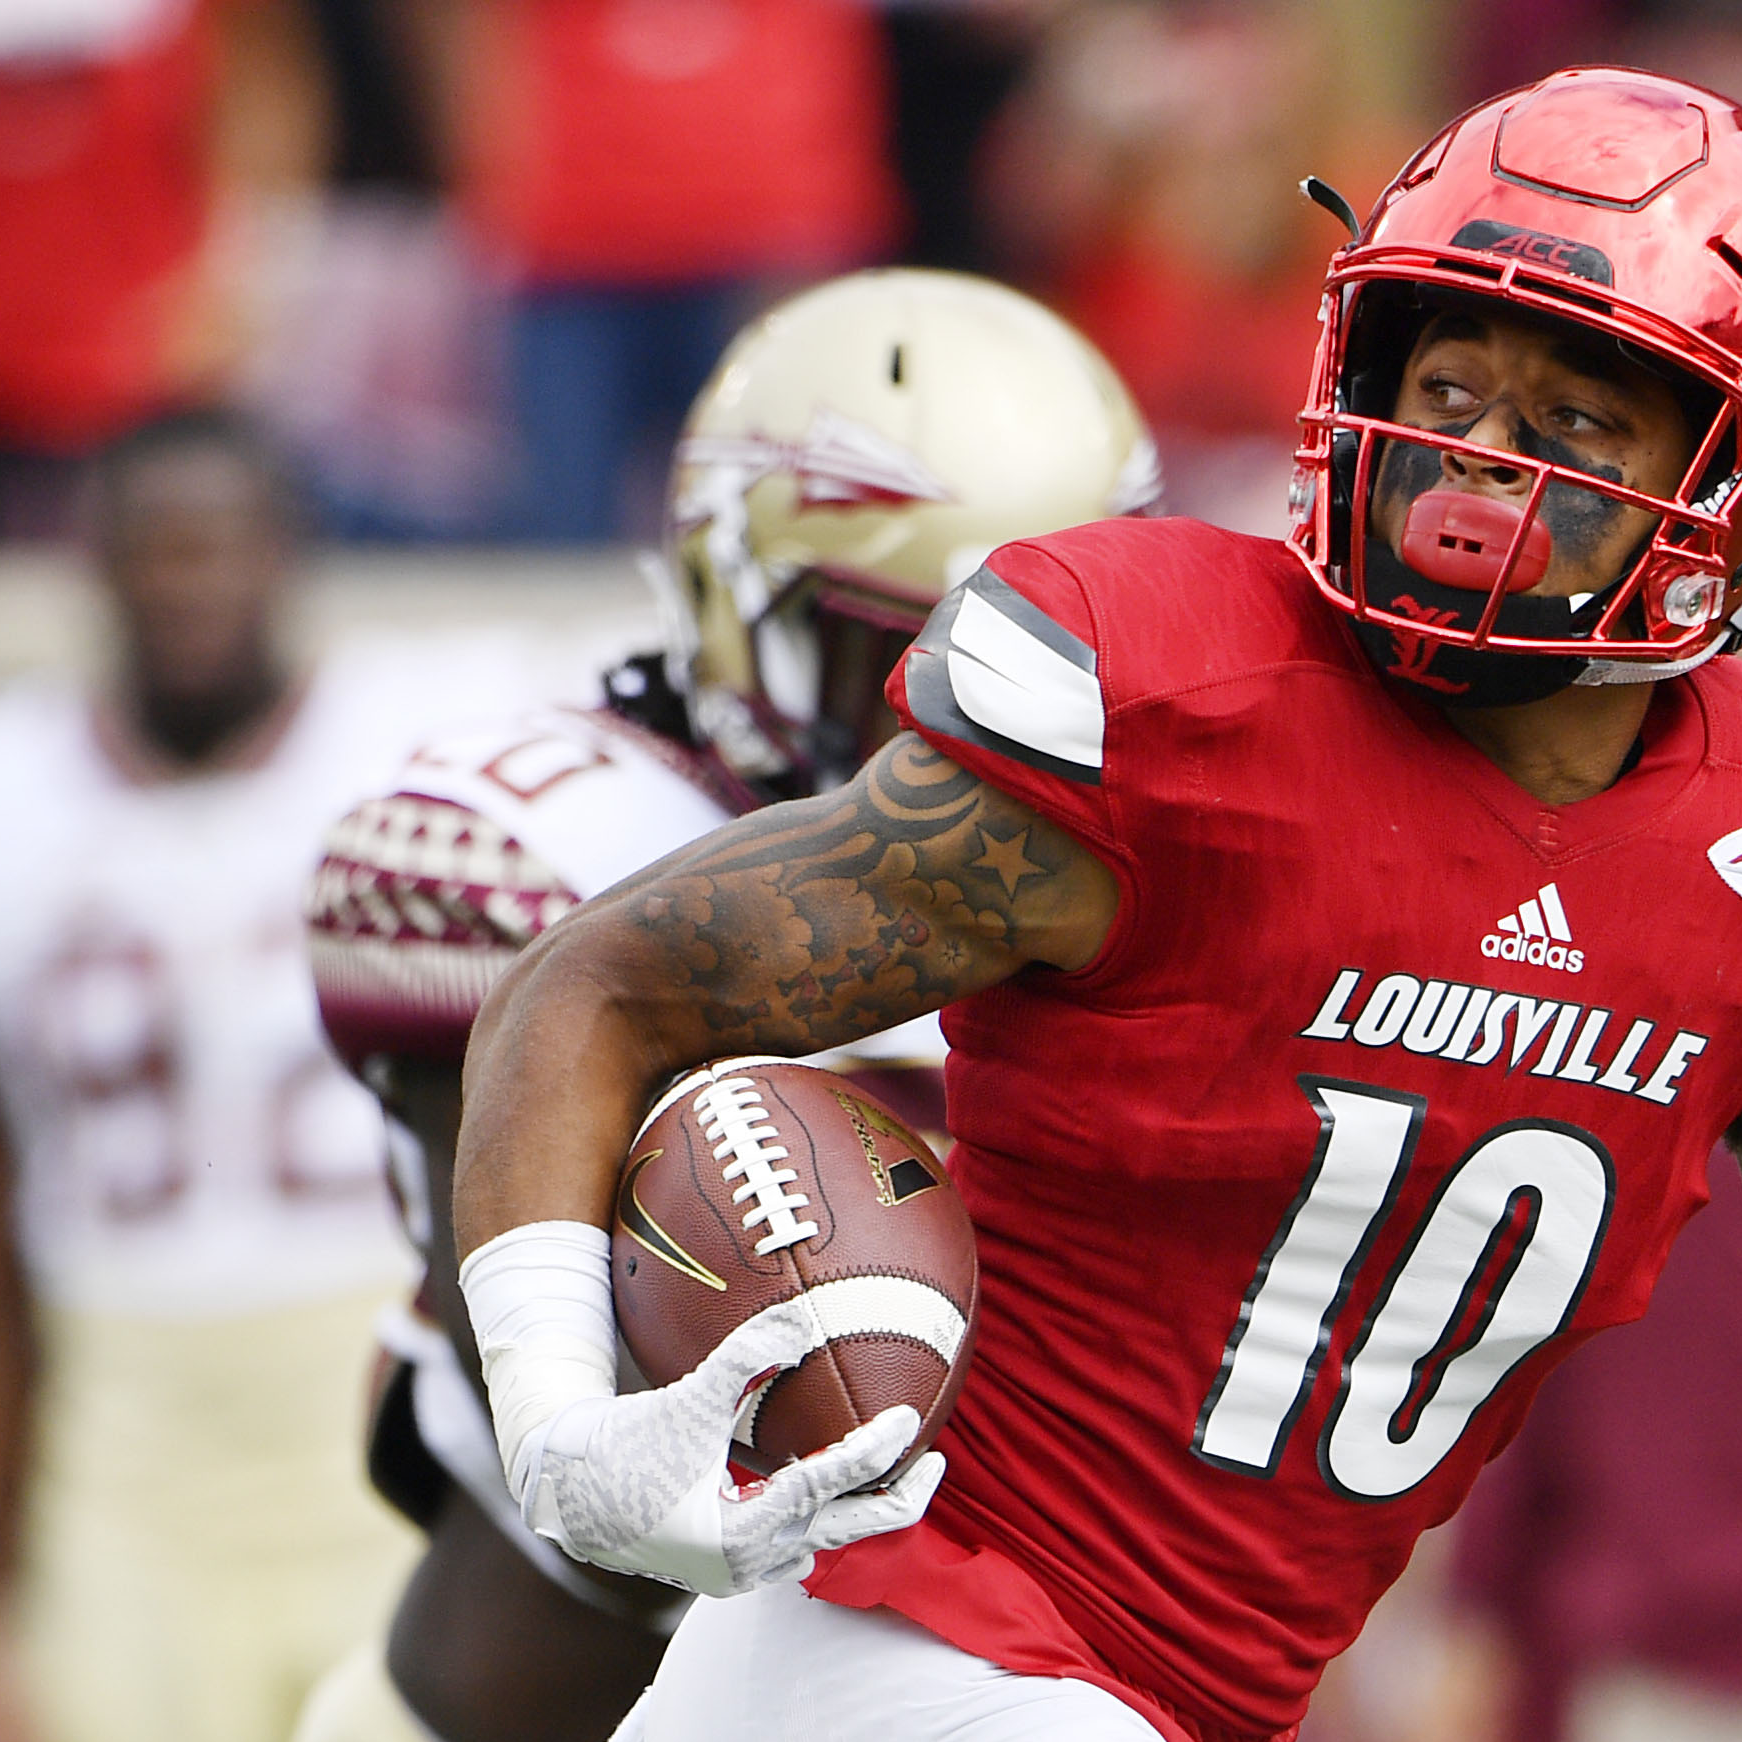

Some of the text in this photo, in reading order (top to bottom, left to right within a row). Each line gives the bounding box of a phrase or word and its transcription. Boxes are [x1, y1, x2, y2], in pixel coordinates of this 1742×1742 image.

[1490, 233, 1580, 268] ACC
[1480, 932, 1585, 974] adidas
[1297, 967, 1711, 1107] LOUISVILLE
[1189, 1073, 1615, 1505] 10
